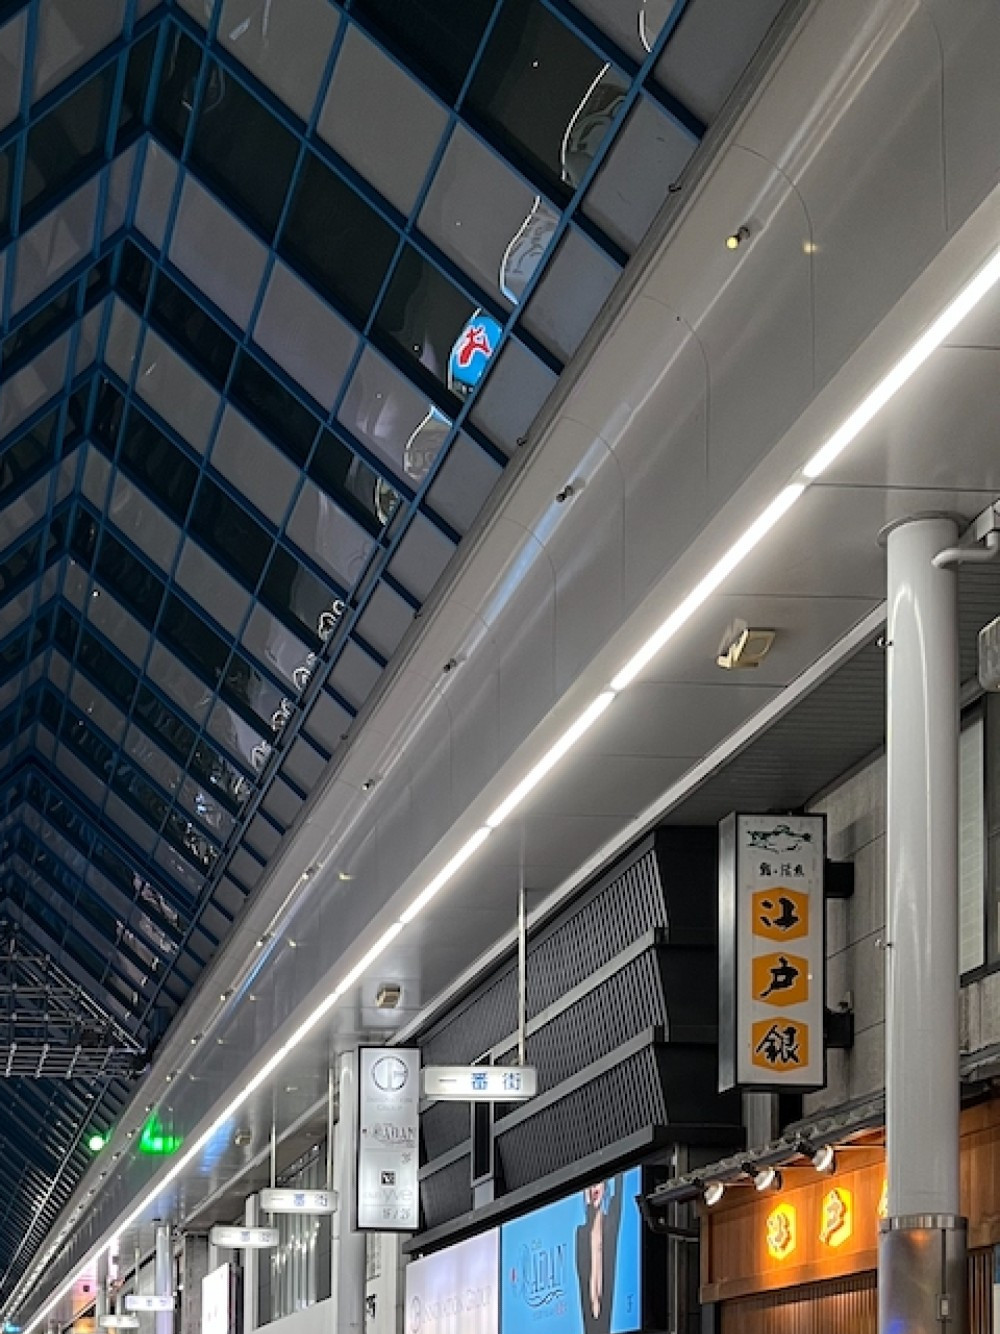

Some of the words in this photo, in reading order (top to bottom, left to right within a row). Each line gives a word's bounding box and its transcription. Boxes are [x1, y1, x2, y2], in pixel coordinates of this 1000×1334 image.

[756, 897, 801, 1064] 江戸銀
[439, 1073, 522, 1091] 一番街
